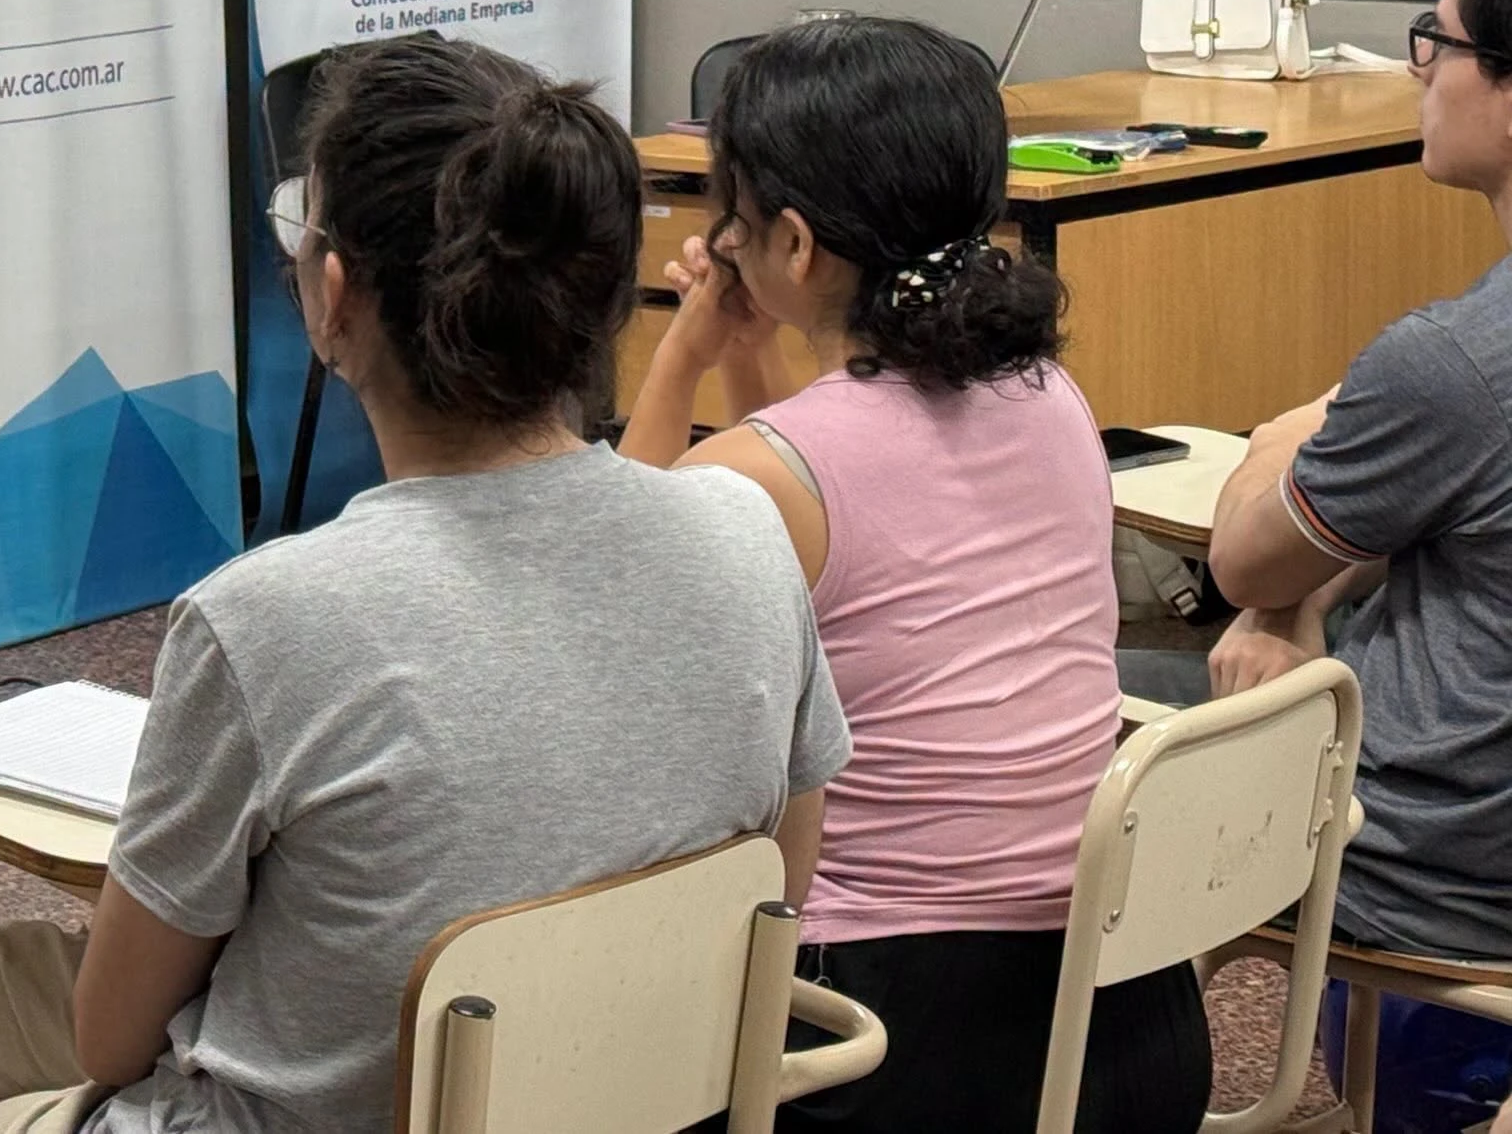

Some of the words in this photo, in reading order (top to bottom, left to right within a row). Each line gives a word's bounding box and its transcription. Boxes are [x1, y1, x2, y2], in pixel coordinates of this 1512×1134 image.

[355, 15, 375, 33] de
[380, 9, 394, 30] la
[399, 5, 466, 29] Mediana
